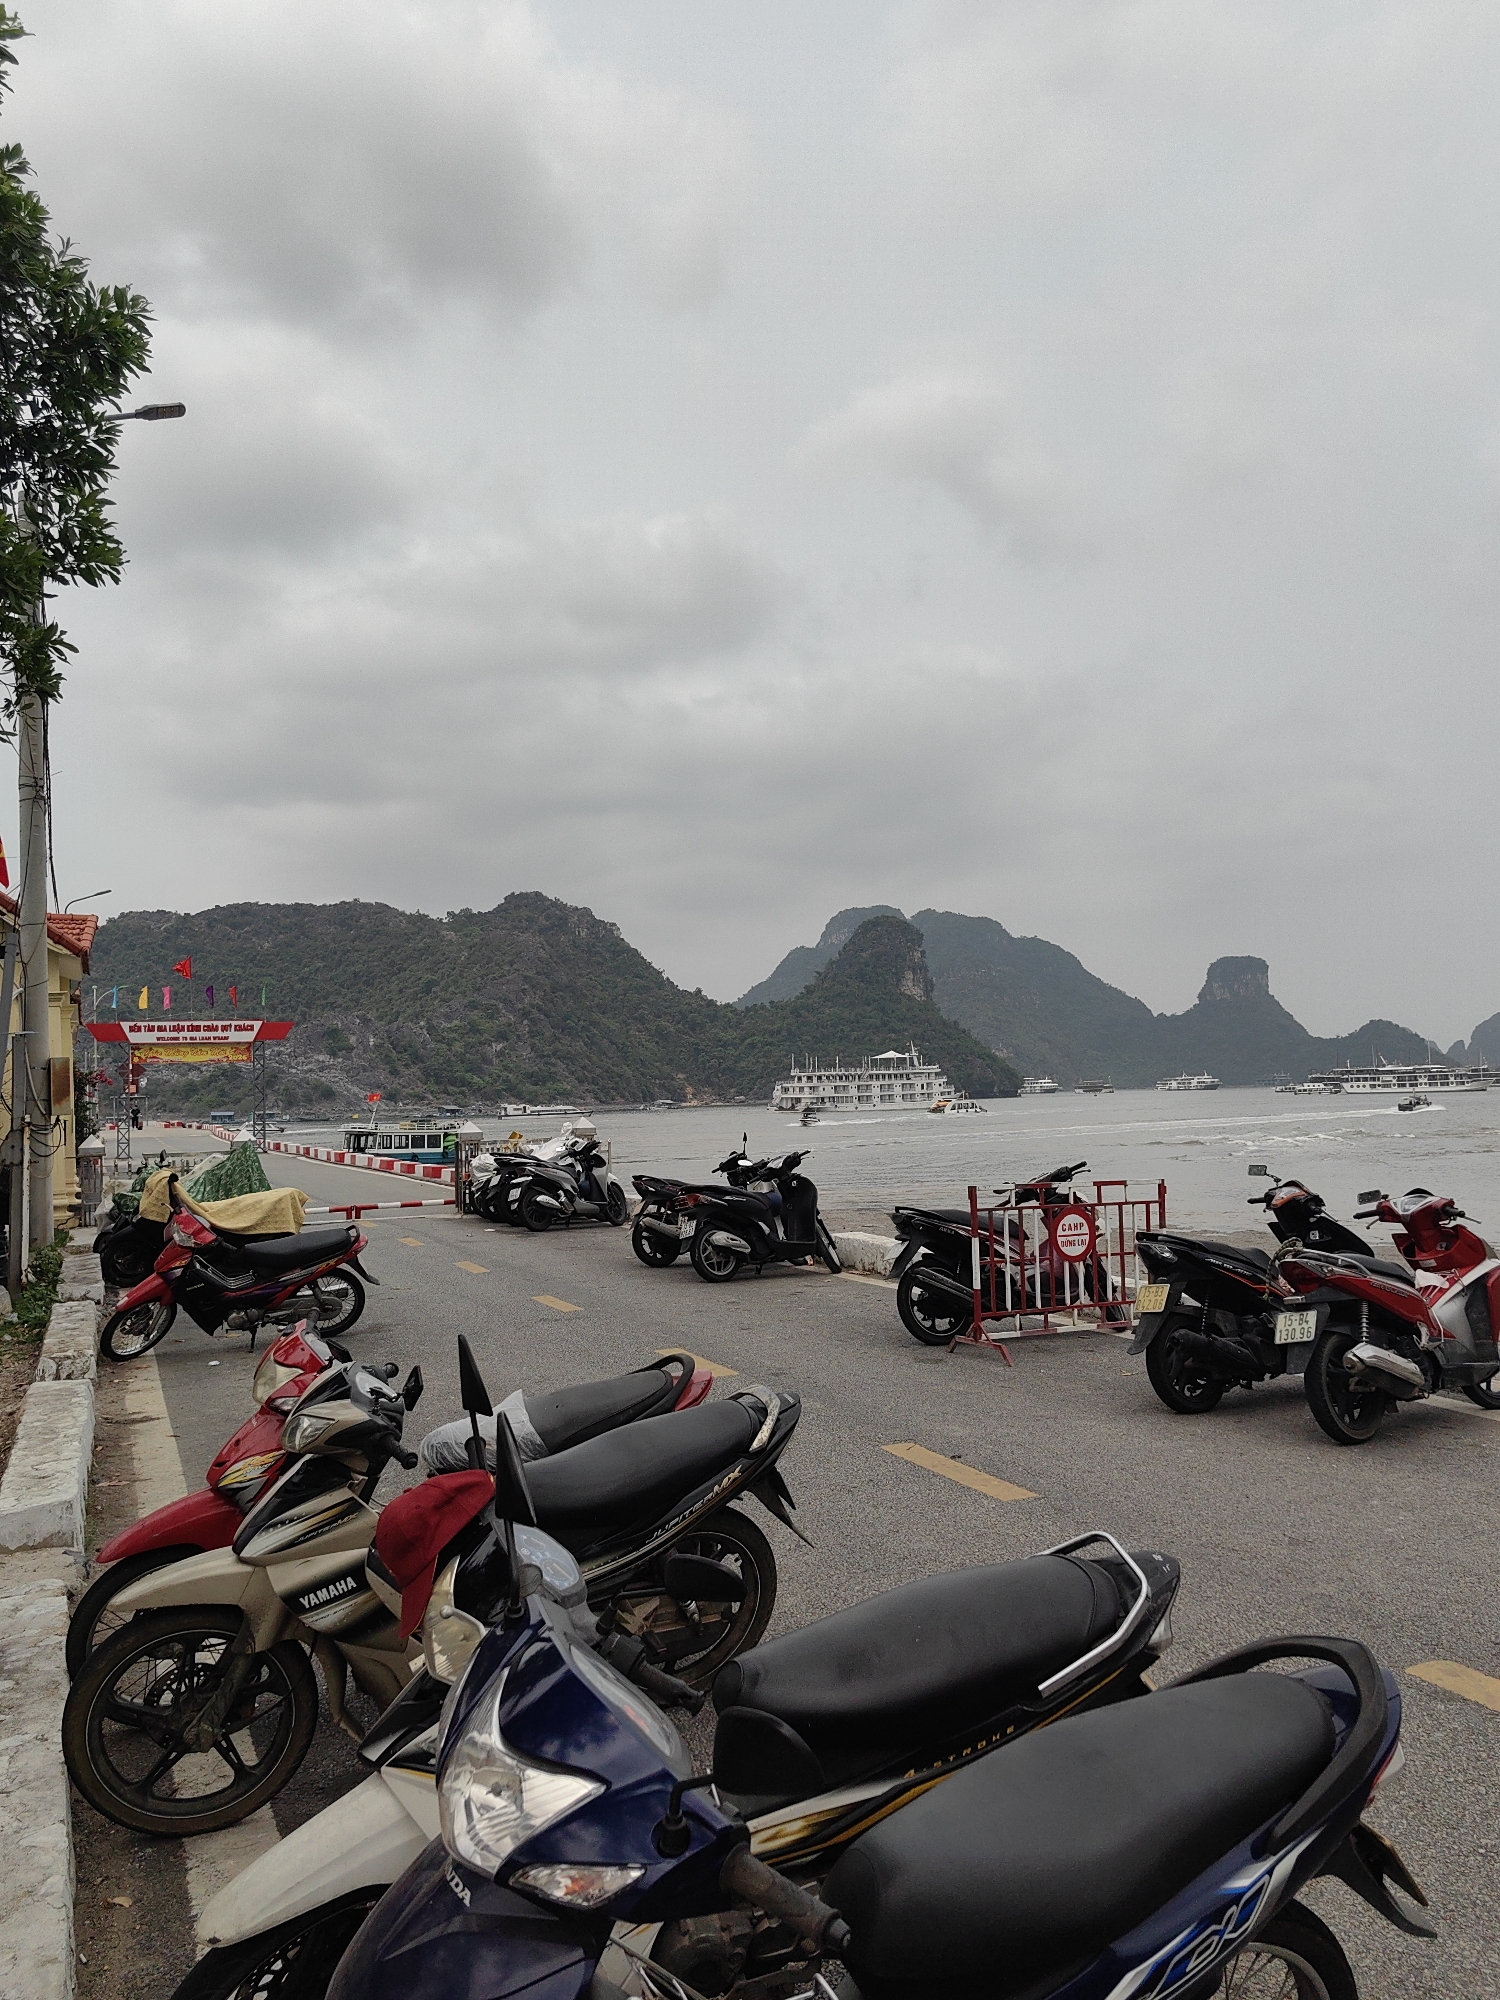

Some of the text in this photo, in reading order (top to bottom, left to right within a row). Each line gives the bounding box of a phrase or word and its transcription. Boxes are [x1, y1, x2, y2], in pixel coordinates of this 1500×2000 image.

[202, 1023, 219, 1032] CHÀO
[234, 1023, 255, 1032] KHÁCH
[1061, 1222, 1084, 1232] CAHP
[1077, 1238, 1087, 1248] LẠI
[1283, 1313, 1310, 1328] 15-B4
[1278, 1326, 1312, 1342] 130.96
[299, 1576, 358, 1610] YAMAHA
[445, 1859, 471, 1908] NDA
